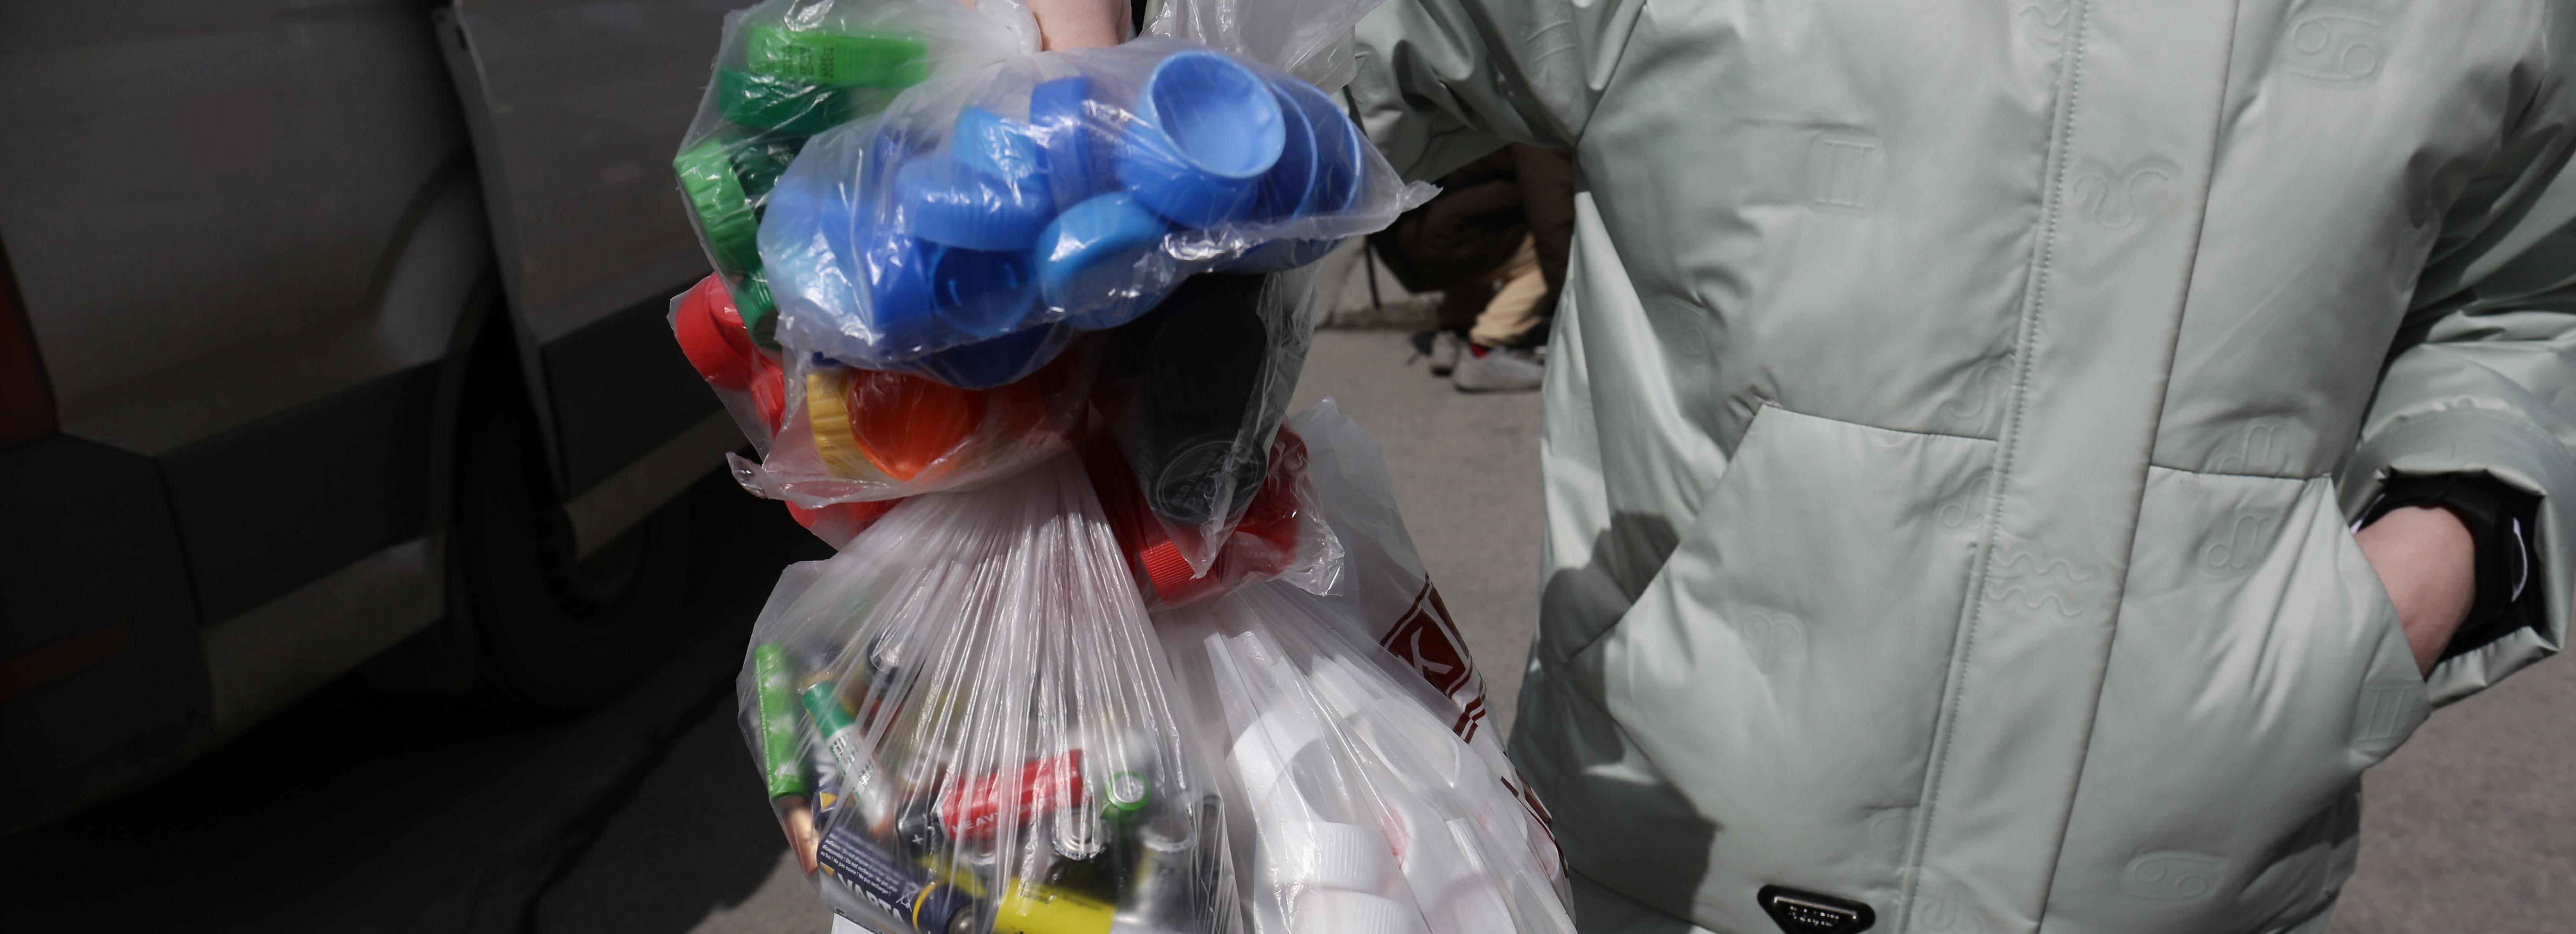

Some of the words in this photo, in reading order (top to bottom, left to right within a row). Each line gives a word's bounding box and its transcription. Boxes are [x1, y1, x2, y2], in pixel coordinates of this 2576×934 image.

[1186, 450, 1218, 483] HOUSE
[952, 812, 998, 833] HEAV
[837, 872, 907, 927] VARTA
